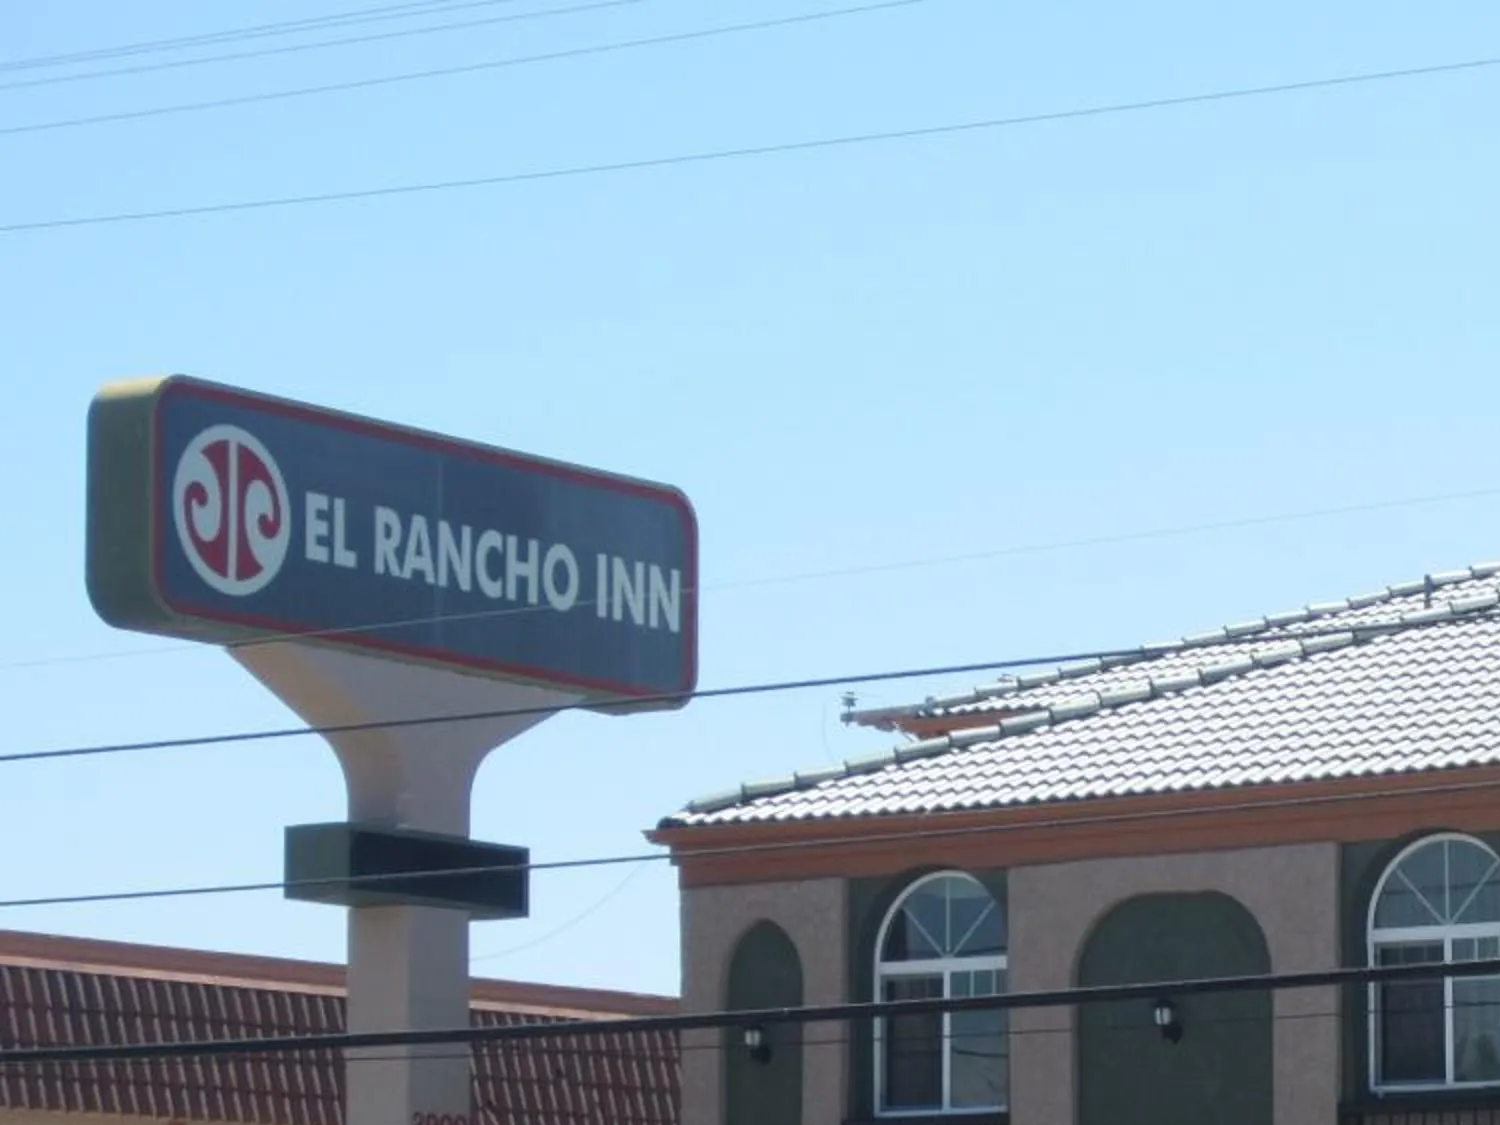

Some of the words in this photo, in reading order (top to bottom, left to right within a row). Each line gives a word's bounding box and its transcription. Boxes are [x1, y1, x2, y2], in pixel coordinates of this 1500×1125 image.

[304, 491, 357, 569] EL
[374, 504, 579, 611] RANCHO
[596, 552, 681, 633] INN
